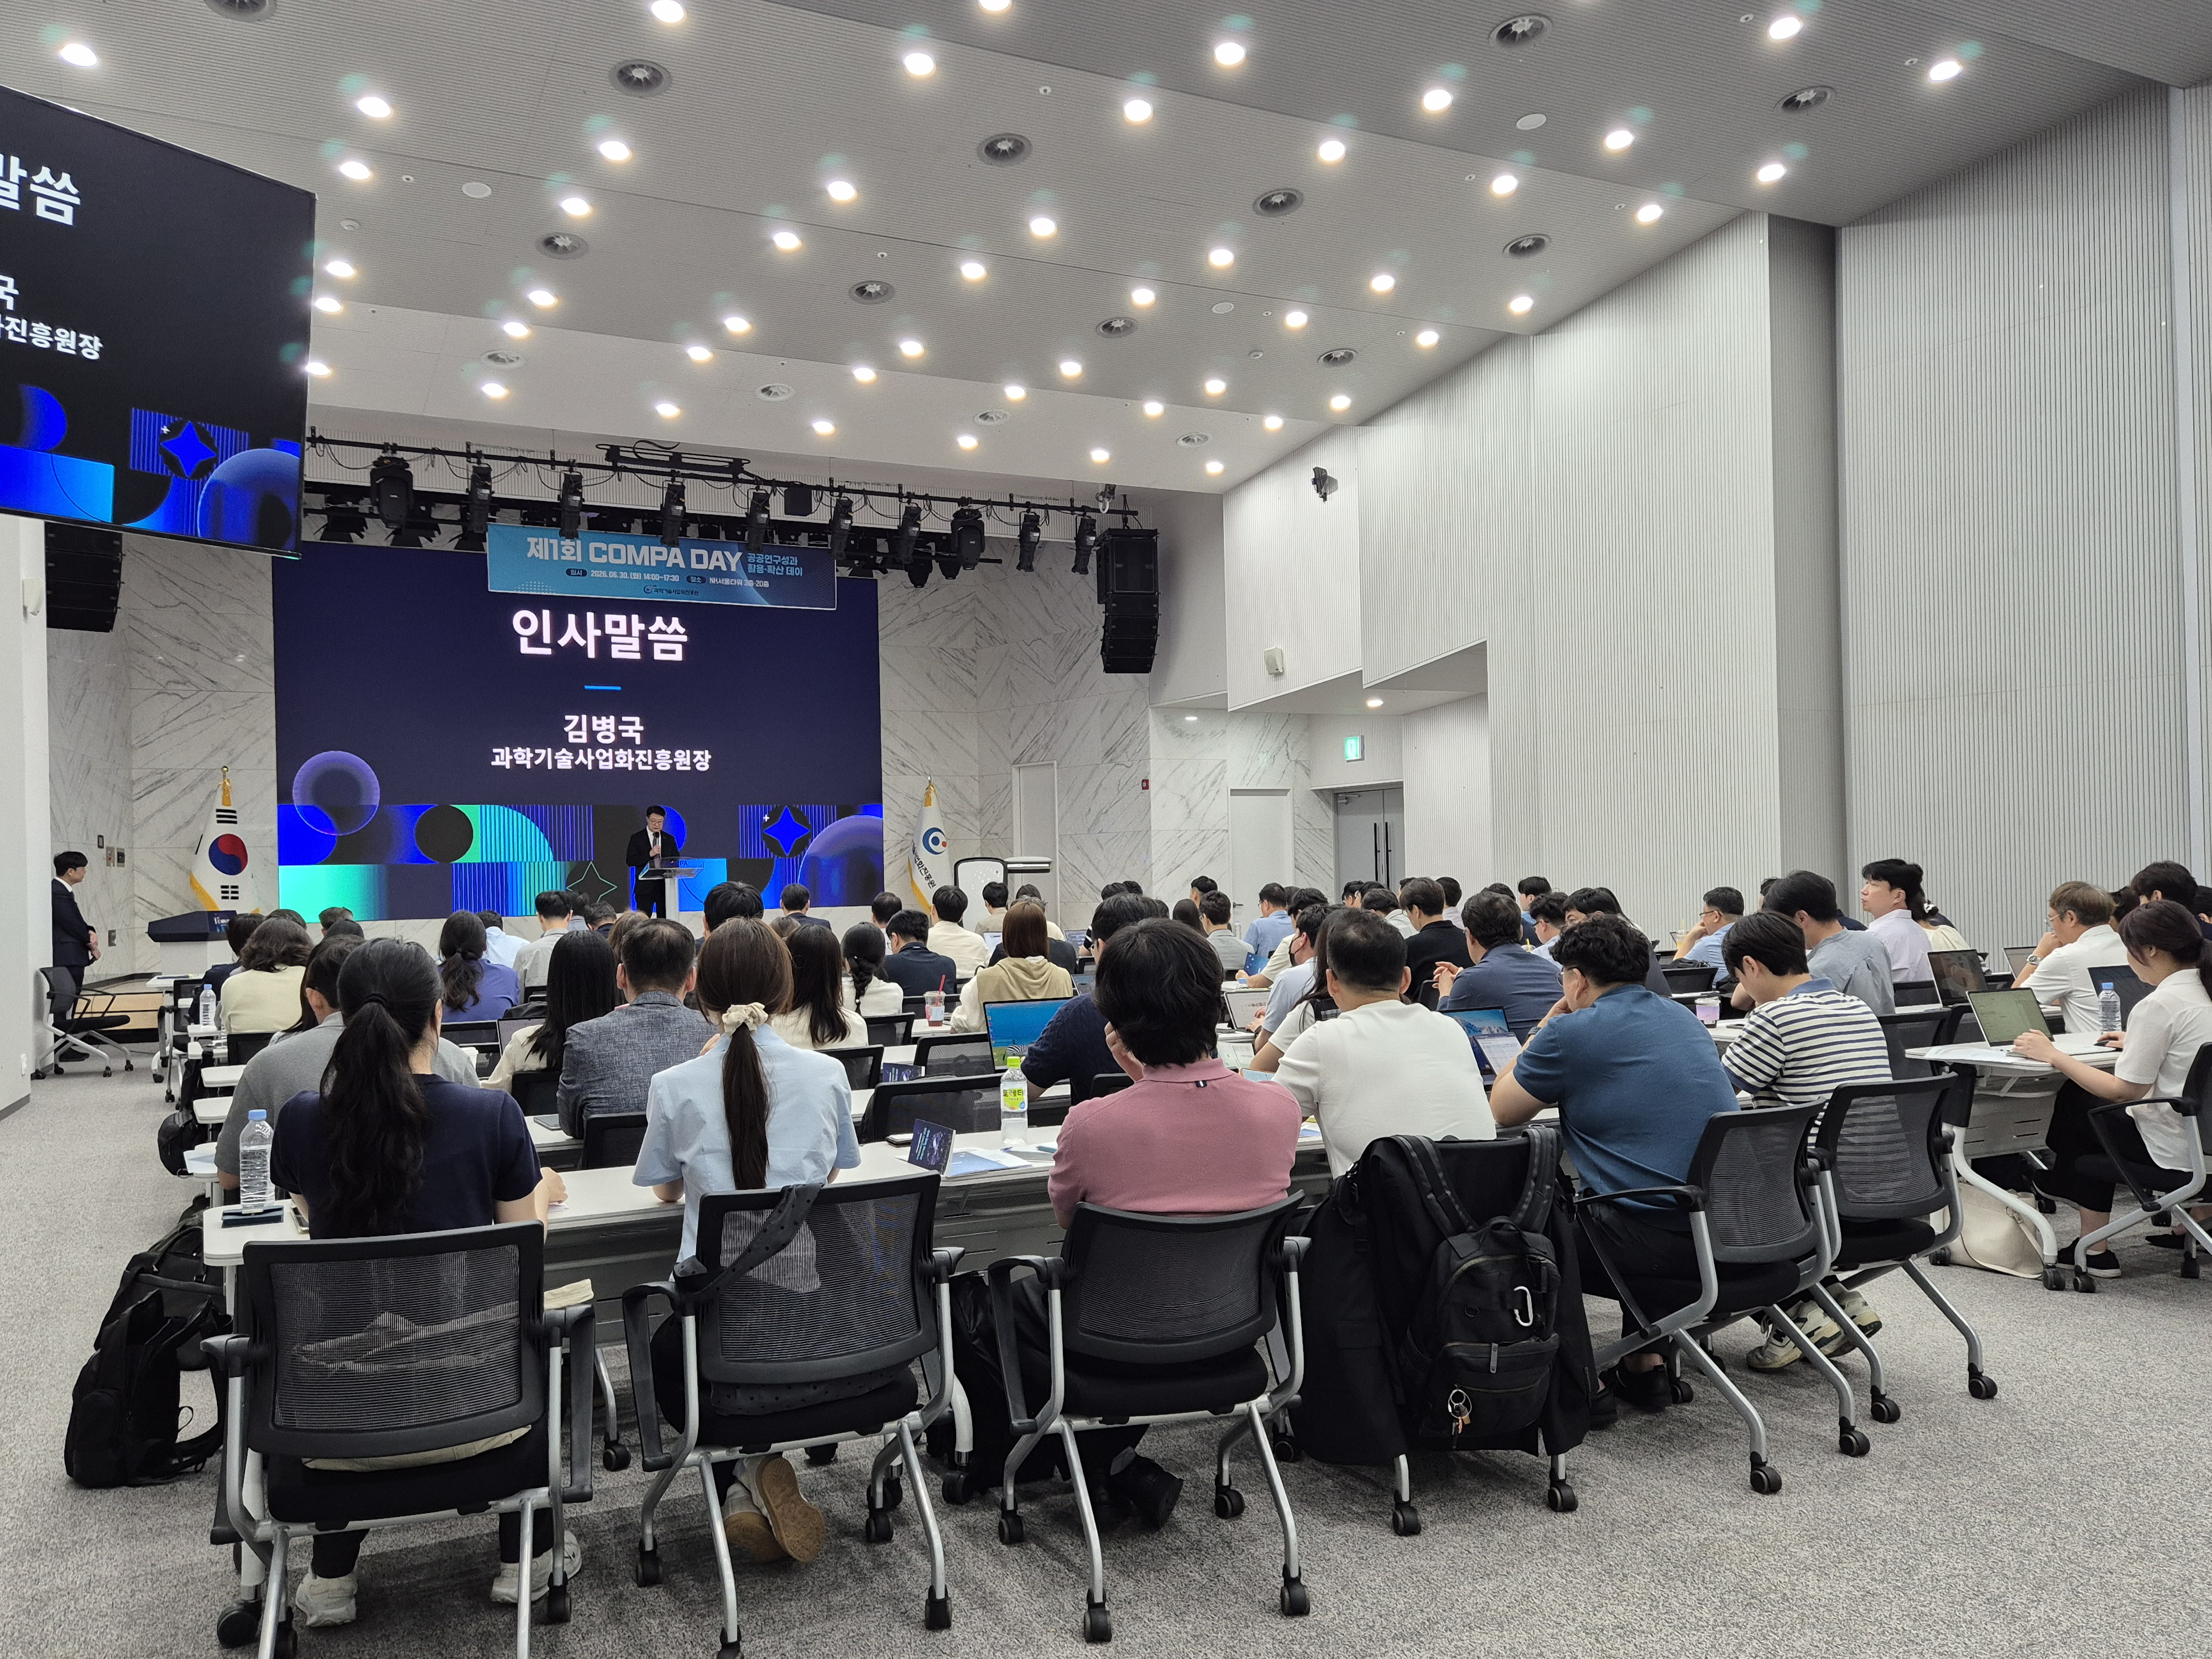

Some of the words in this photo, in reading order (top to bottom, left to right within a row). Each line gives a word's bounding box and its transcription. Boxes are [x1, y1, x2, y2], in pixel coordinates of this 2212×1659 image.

[0, 313, 104, 361] 진흥원장
[527, 537, 582, 562] 제1회
[589, 542, 686, 568] COMPA
[690, 549, 743, 572] DAY
[747, 553, 798, 566] 공공연구성과
[786, 566, 803, 576] 데이
[512, 609, 688, 661] 인사말씀
[564, 714, 644, 745] 김병국
[491, 747, 712, 771] 과학기술사업화진흥원장
